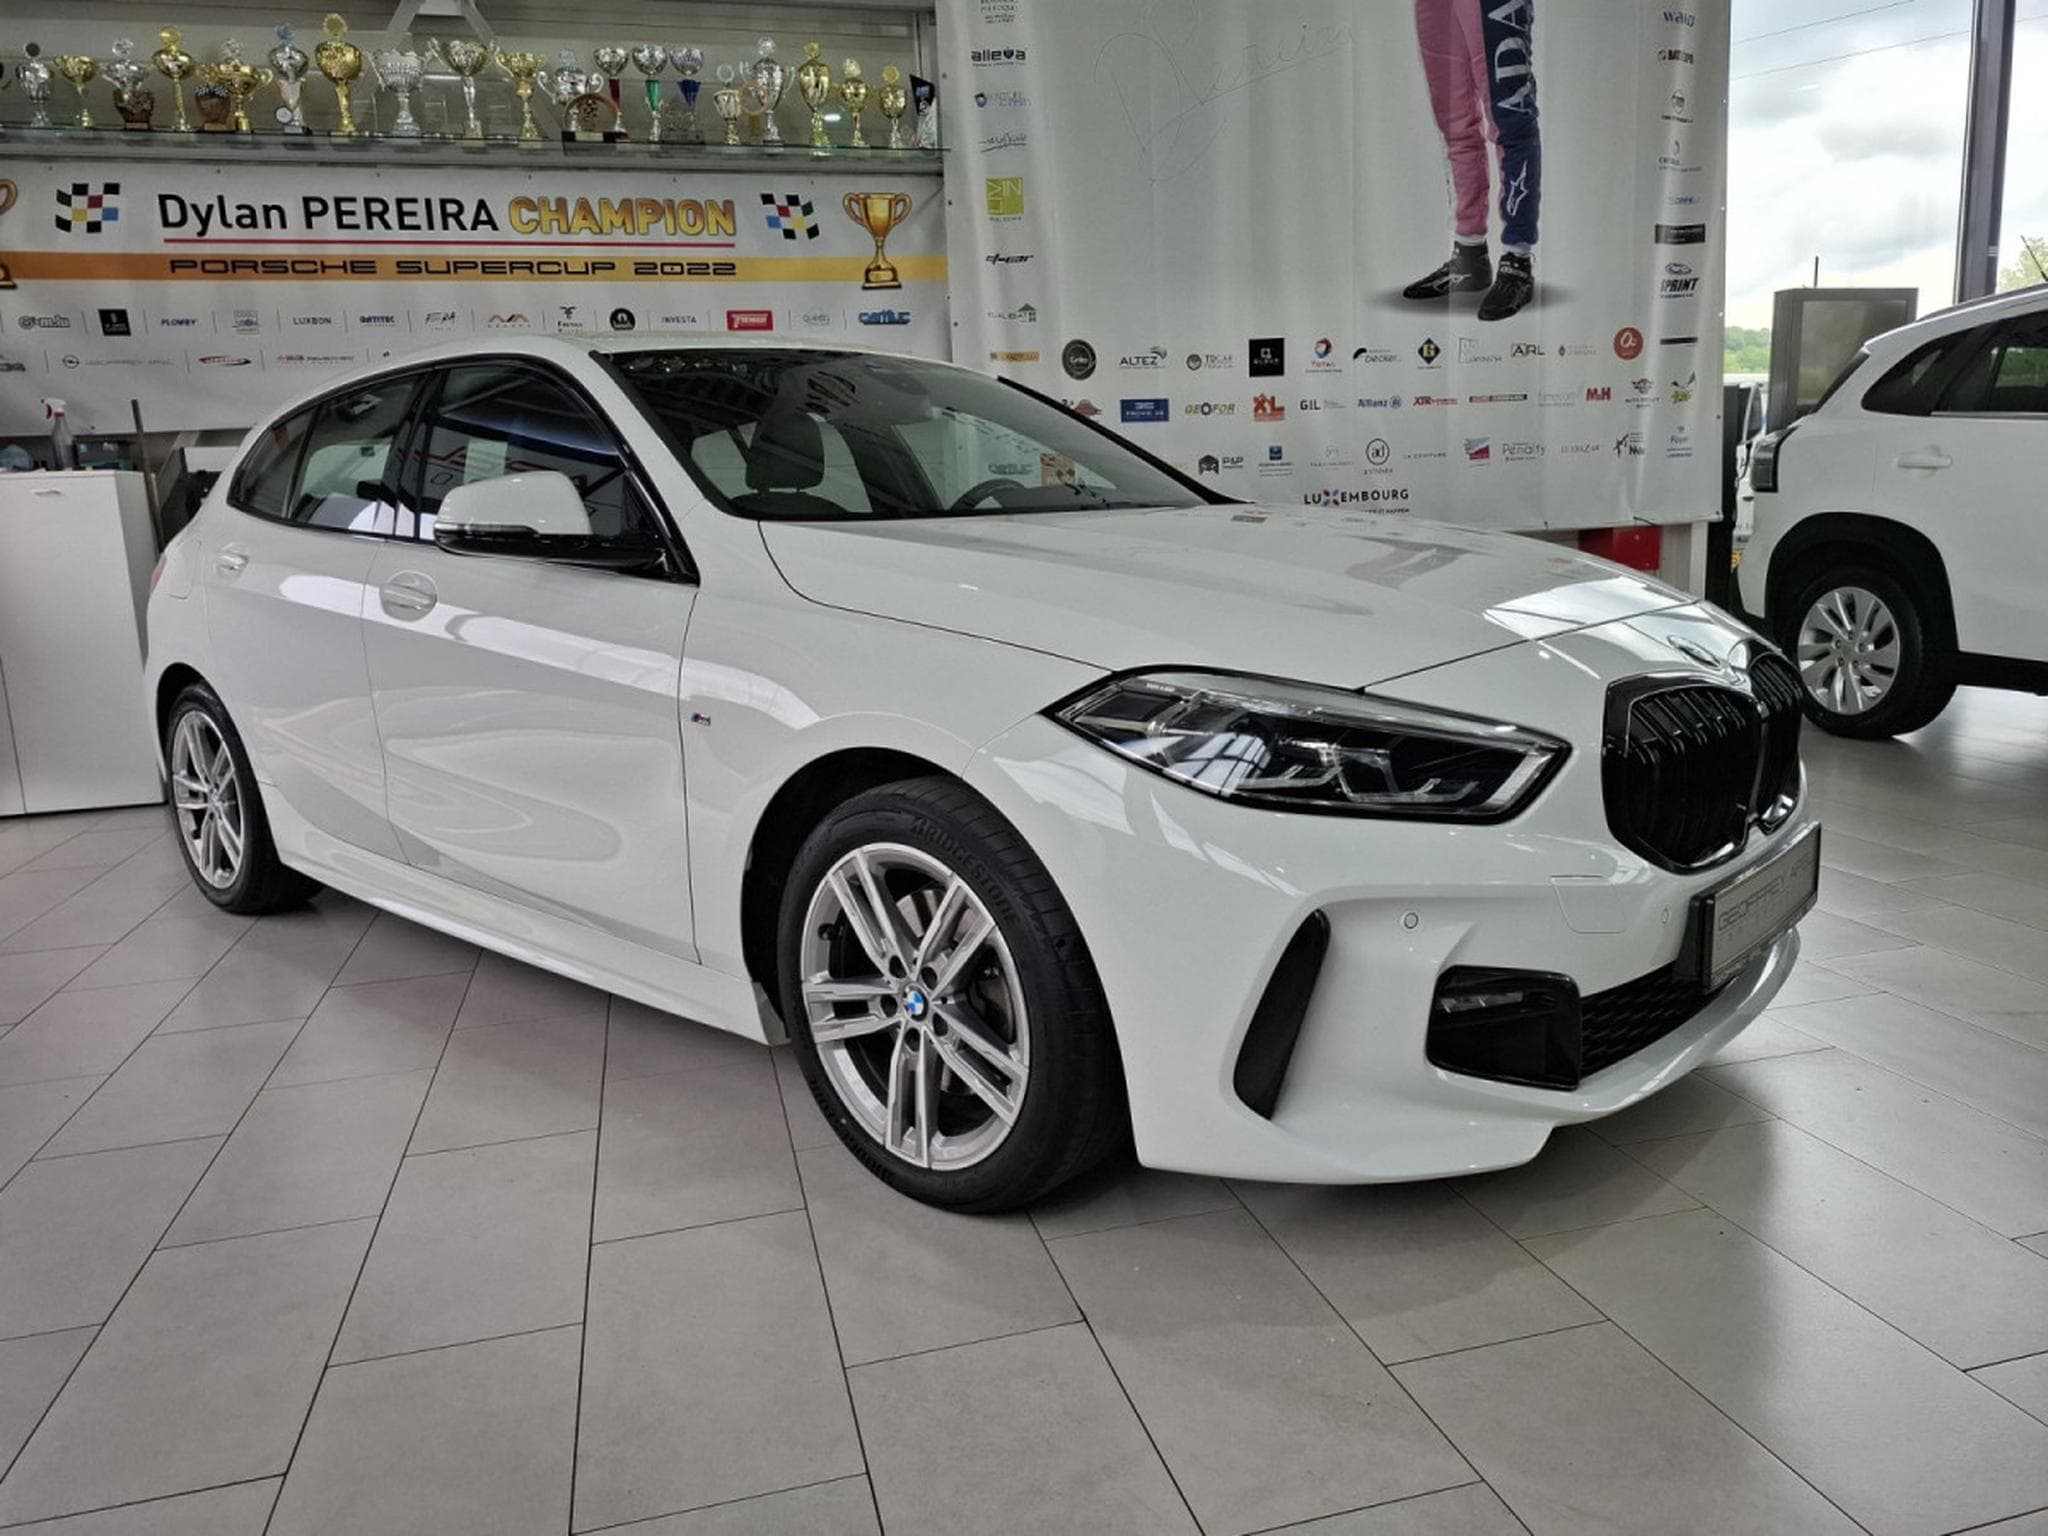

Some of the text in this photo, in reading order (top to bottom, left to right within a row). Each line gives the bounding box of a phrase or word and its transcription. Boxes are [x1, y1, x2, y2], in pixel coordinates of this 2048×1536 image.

[157, 194, 737, 237] Dylan PEREIRA CHAMPION
[170, 259, 737, 276] PORSCHE SUPERCUP 2022
[662, 315, 697, 324] INVESTA
[1120, 355, 1158, 366] ALTEZ
[1300, 399, 1321, 410] GIL
[1358, 398, 1388, 408] Allianz
[1304, 489, 1409, 506] LUXEMBOURG
